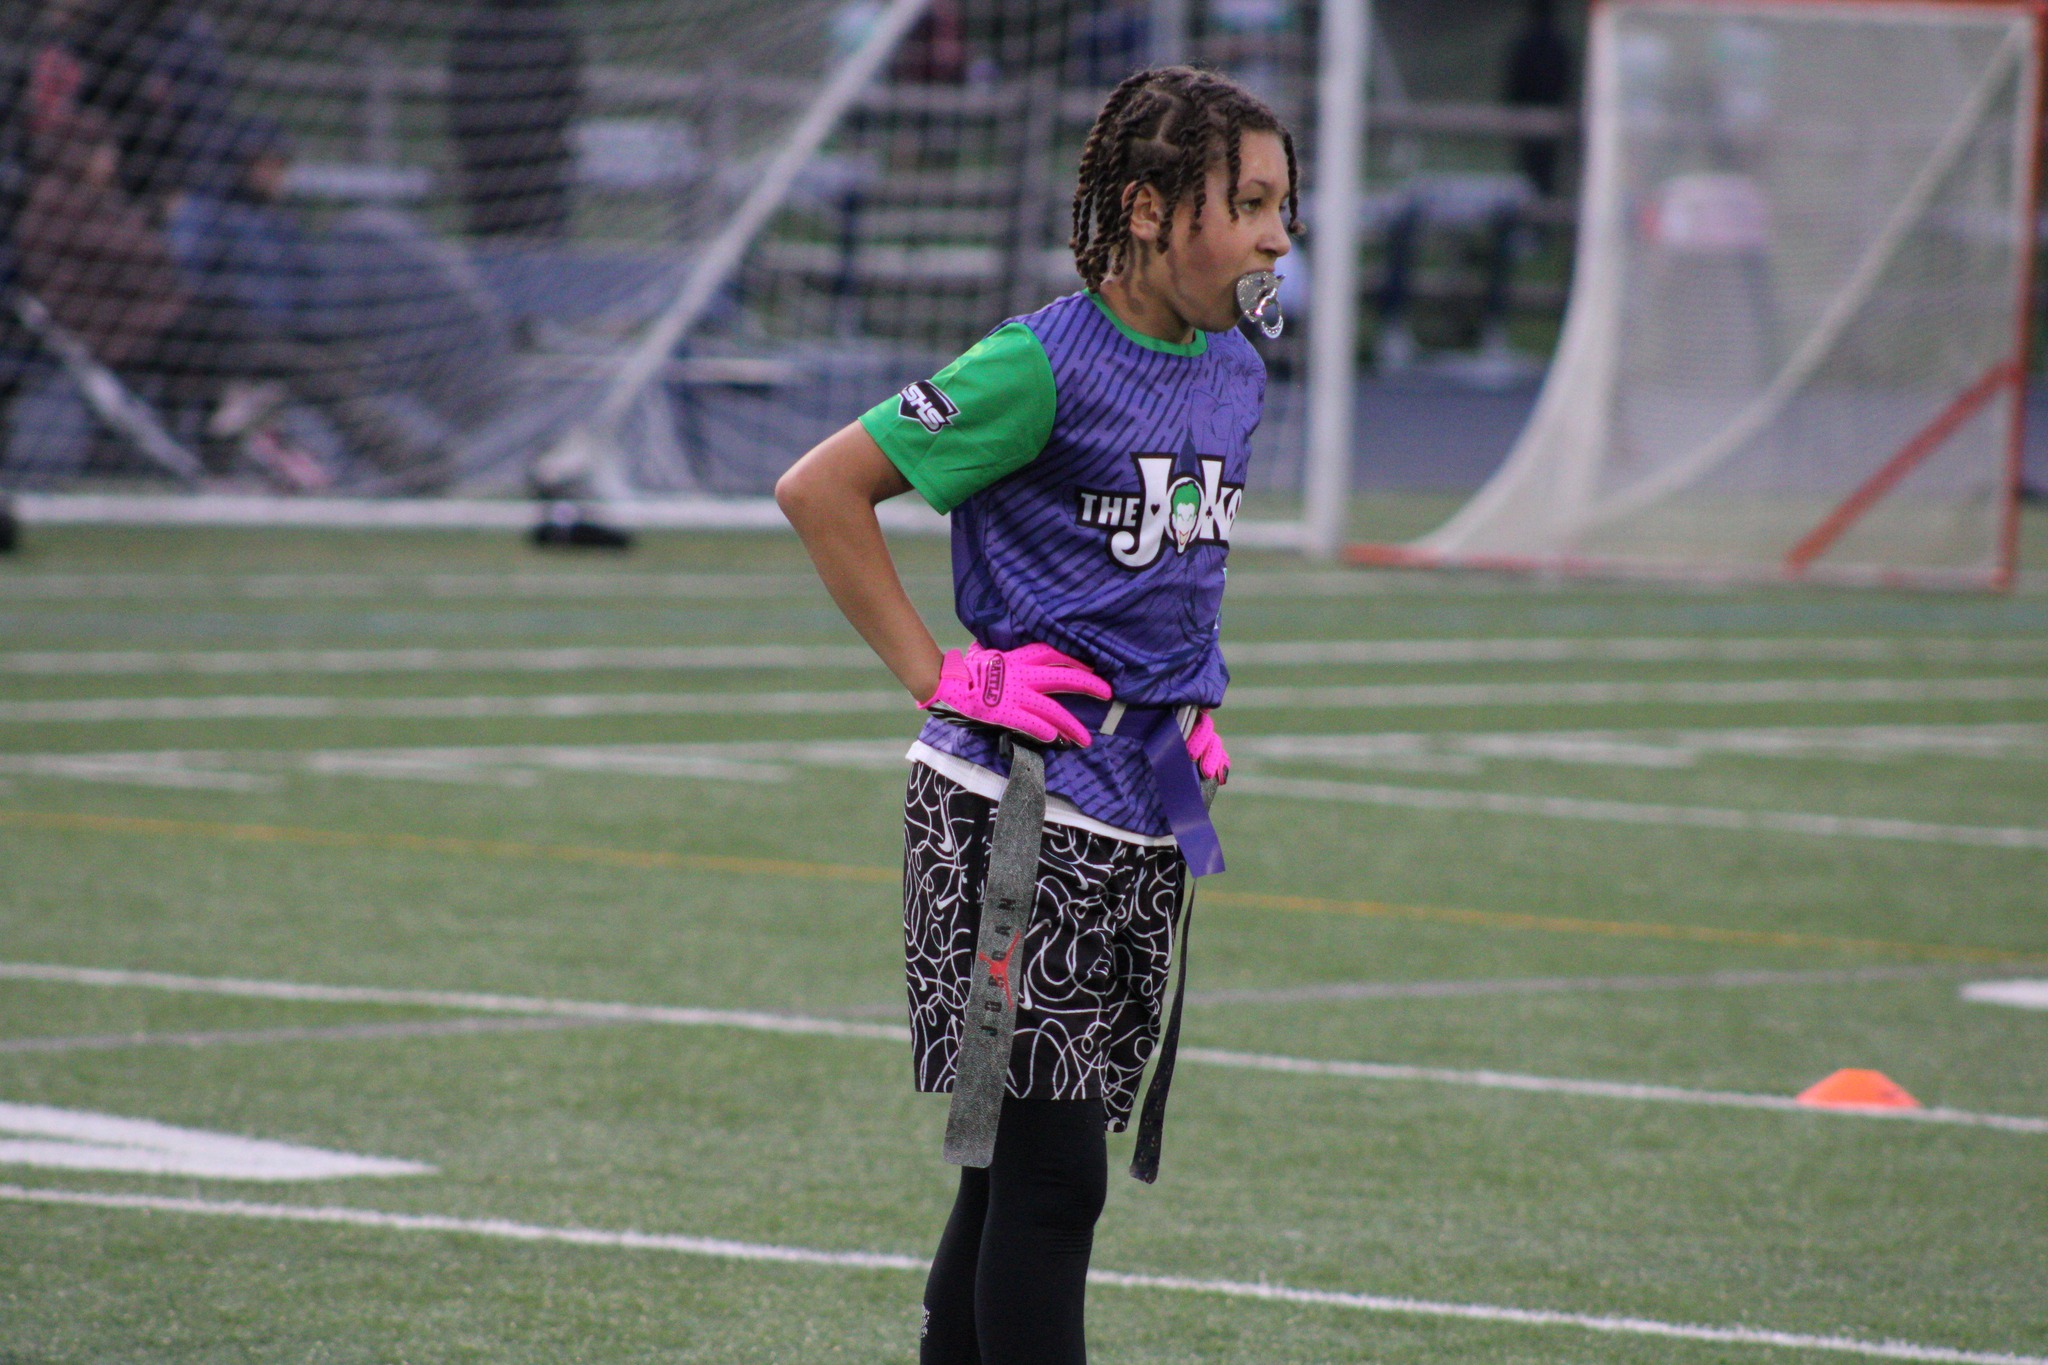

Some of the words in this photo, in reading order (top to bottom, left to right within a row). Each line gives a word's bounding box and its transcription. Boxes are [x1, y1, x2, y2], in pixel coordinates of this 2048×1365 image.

[901, 384, 946, 430] SHS
[1080, 492, 1141, 527] THE
[984, 659, 1004, 704] BATTLE
[980, 897, 1017, 1038] JORDAN
